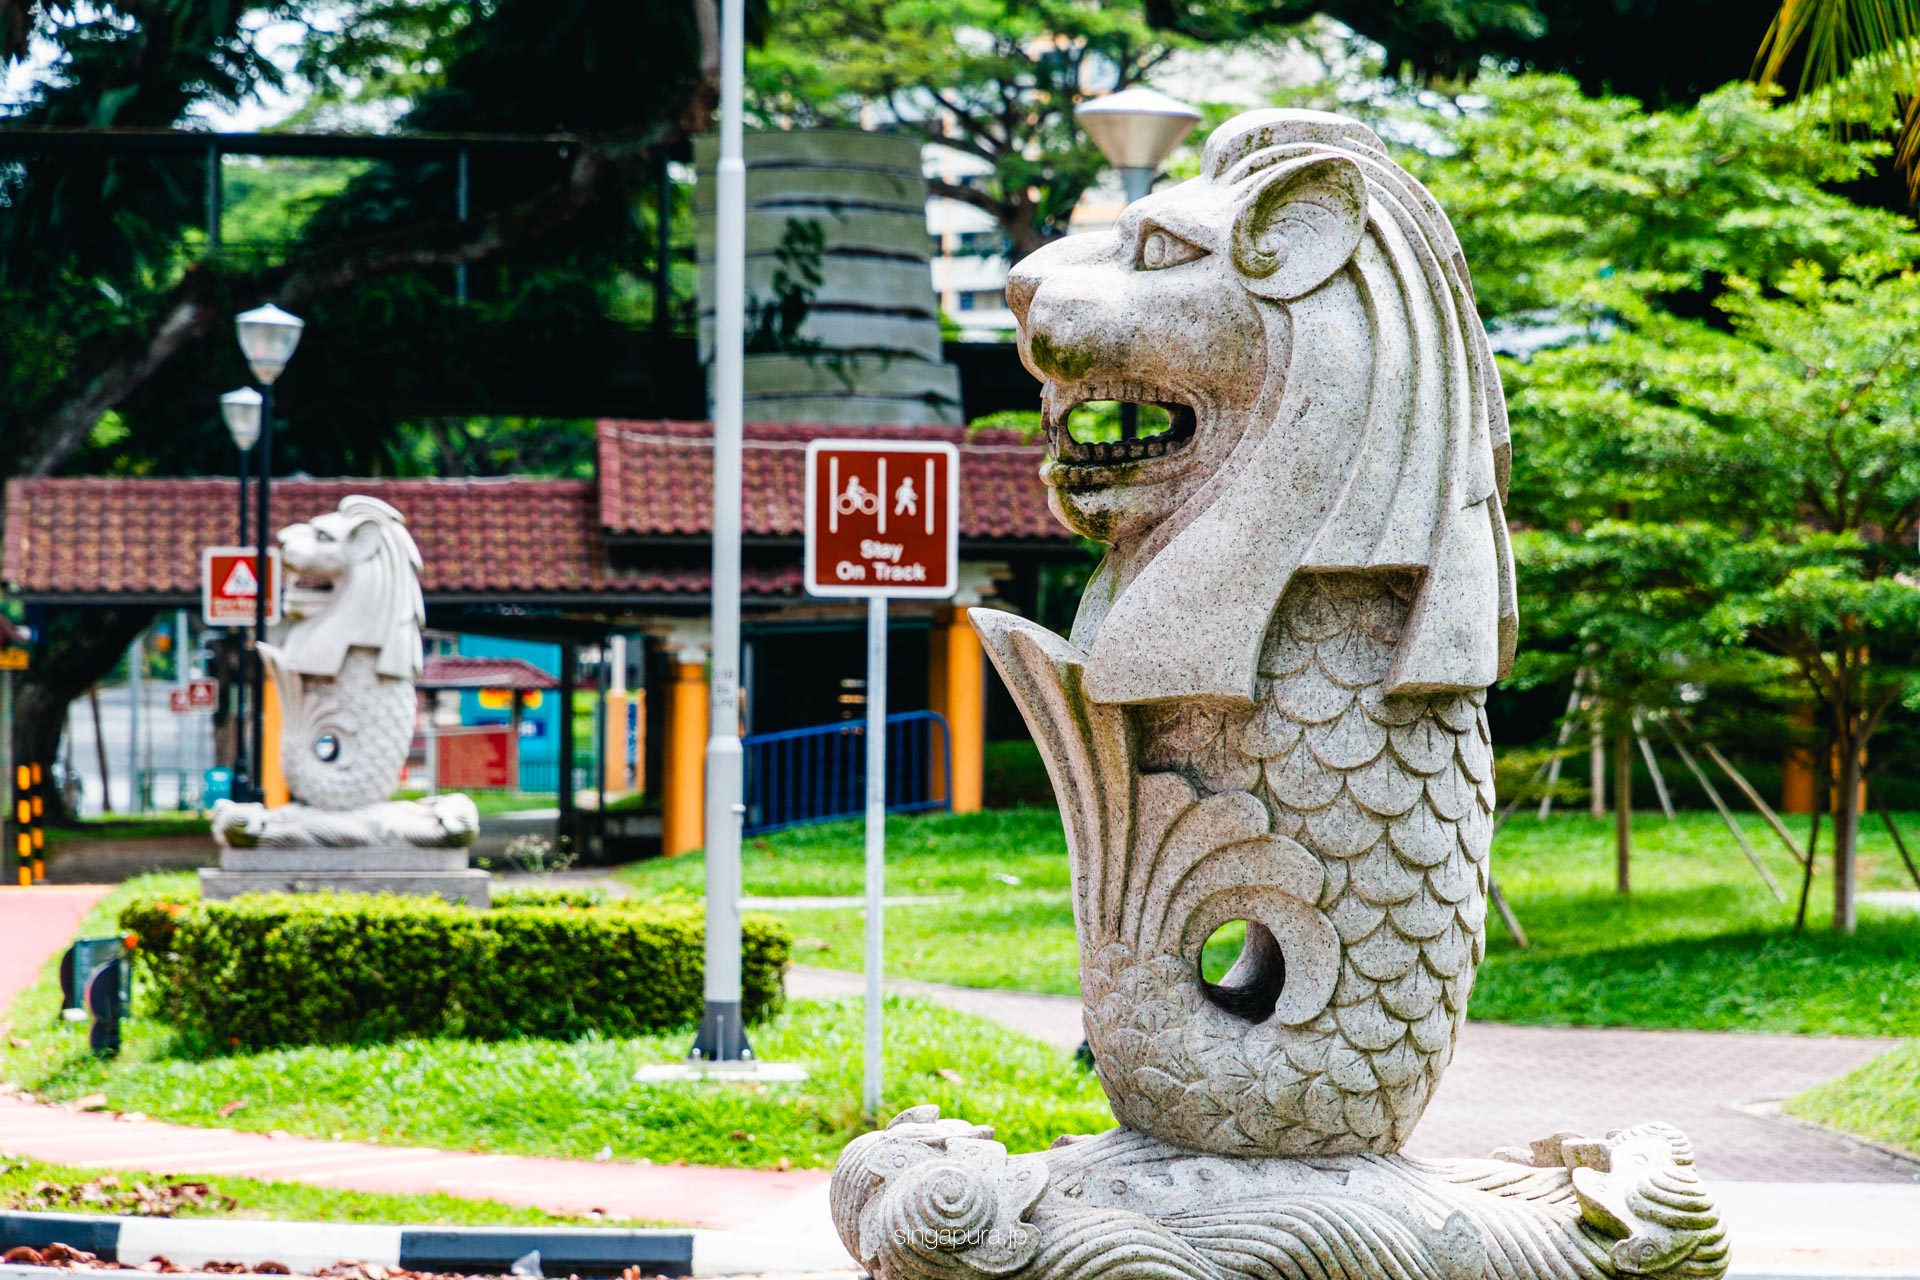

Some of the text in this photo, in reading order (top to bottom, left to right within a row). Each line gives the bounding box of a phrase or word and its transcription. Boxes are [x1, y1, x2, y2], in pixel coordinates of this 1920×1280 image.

[860, 539, 904, 563] Stay
[836, 560, 927, 582] On Track
